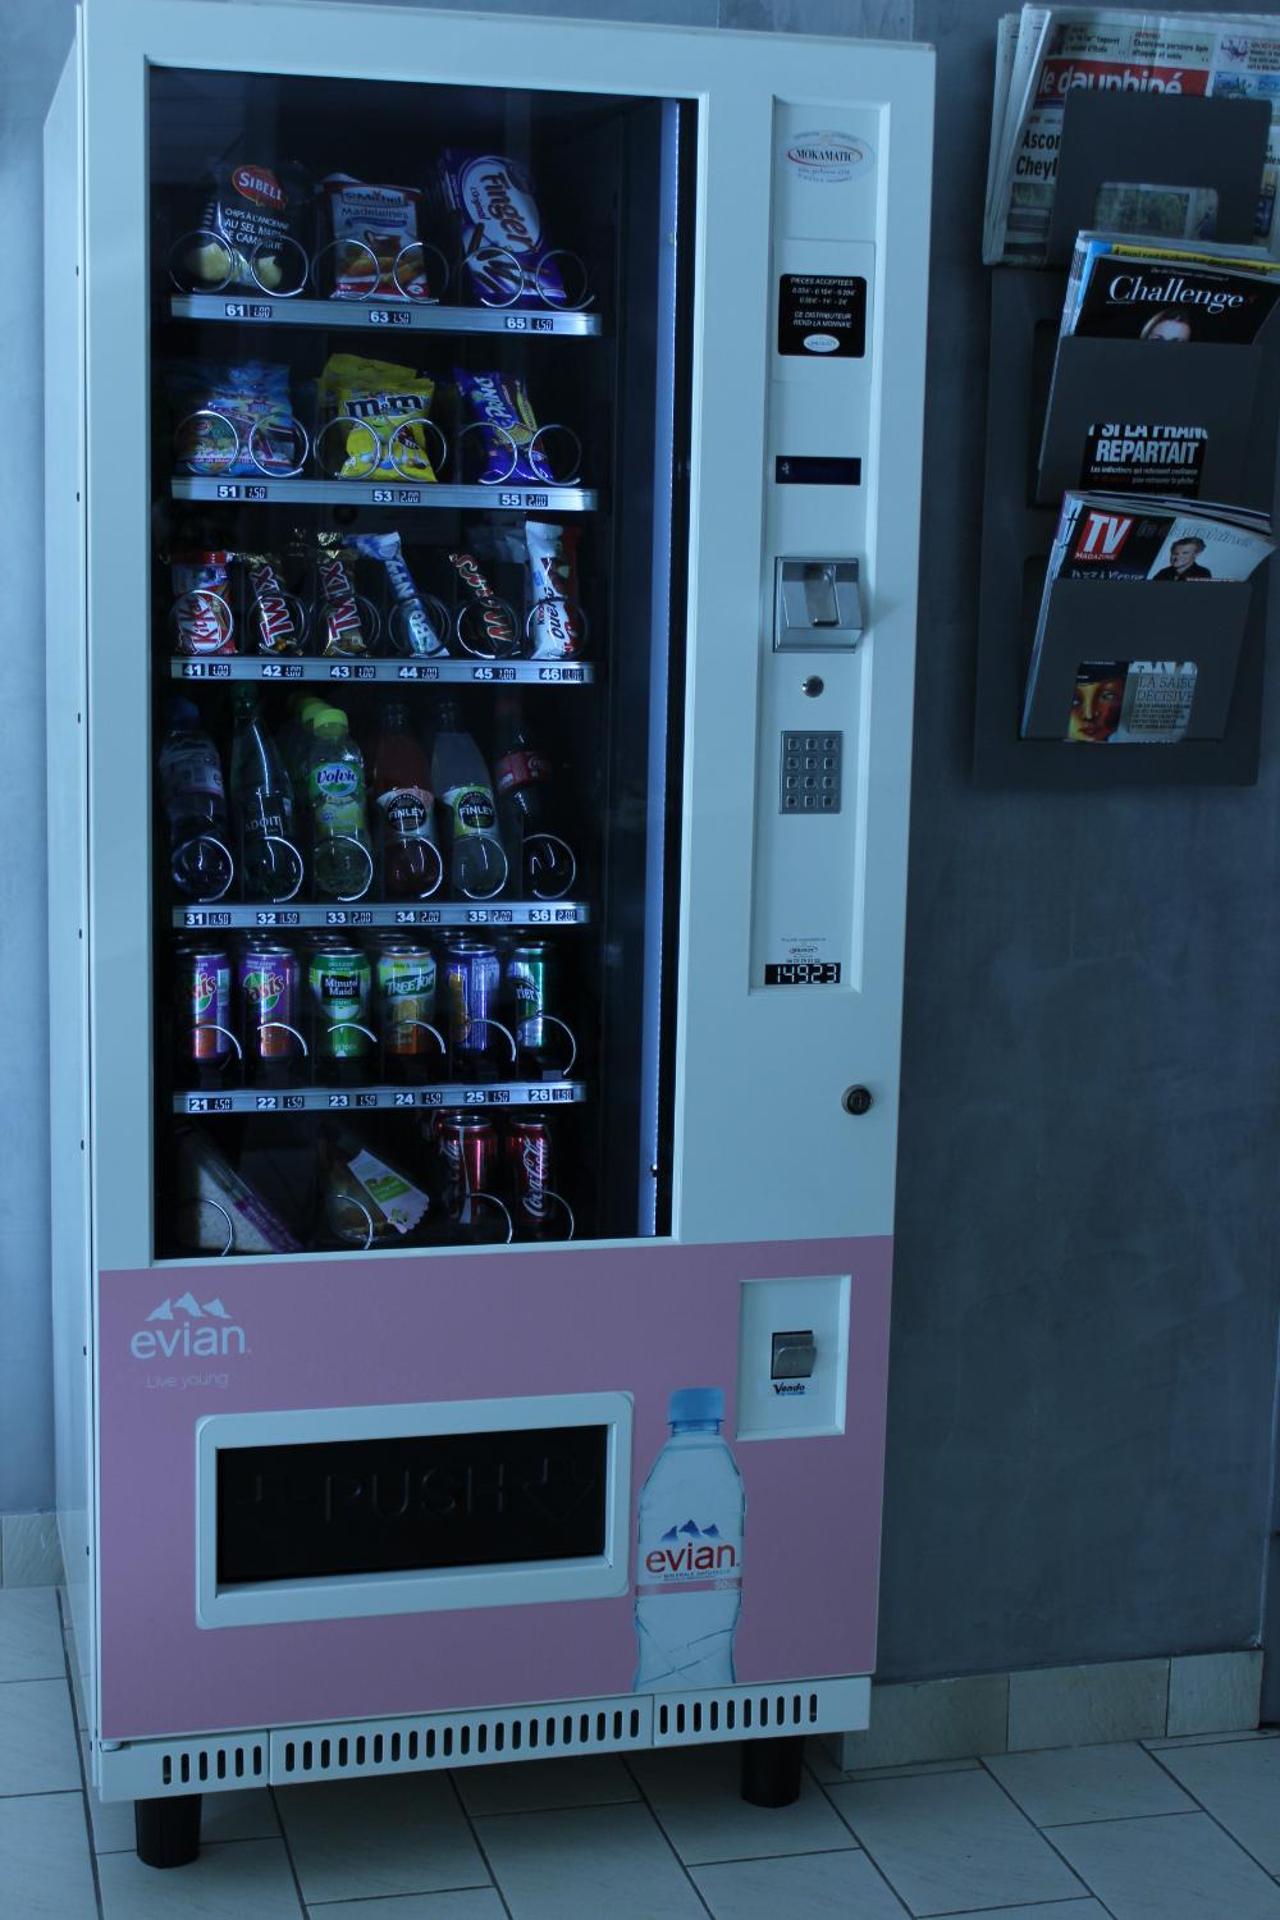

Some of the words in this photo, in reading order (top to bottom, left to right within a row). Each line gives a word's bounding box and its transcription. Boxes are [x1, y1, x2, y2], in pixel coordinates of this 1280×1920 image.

[226, 304, 245, 317] 61
[370, 311, 389, 323] 63
[506, 317, 526, 329] 65
[1096, 439, 1200, 465] REPARTAIT
[218, 486, 238, 498] 51
[373, 490, 392, 502] 53
[501, 494, 520, 506] 55
[1083, 513, 1132, 554] TV
[184, 664, 202, 676] 41
[263, 665, 281, 677] 42
[330, 666, 350, 678] 43
[399, 667, 418, 678] 44
[474, 668, 493, 679] 45
[541, 668, 560, 680] 46
[186, 913, 203, 925] 31
[257, 913, 276, 924] 32
[327, 912, 346, 924] 33
[396, 911, 416, 922] 34
[468, 910, 487, 922] 35
[531, 910, 549, 921] 36
[777, 963, 837, 984] 14923
[329, 1095, 348, 1106] 23
[395, 1093, 414, 1104] 24
[466, 1091, 485, 1103] 25
[530, 1089, 548, 1101] 26
[190, 1099, 208, 1111] 21
[257, 1097, 276, 1109] 22
[130, 1321, 246, 1360] evian
[645, 1541, 736, 1574] evian
